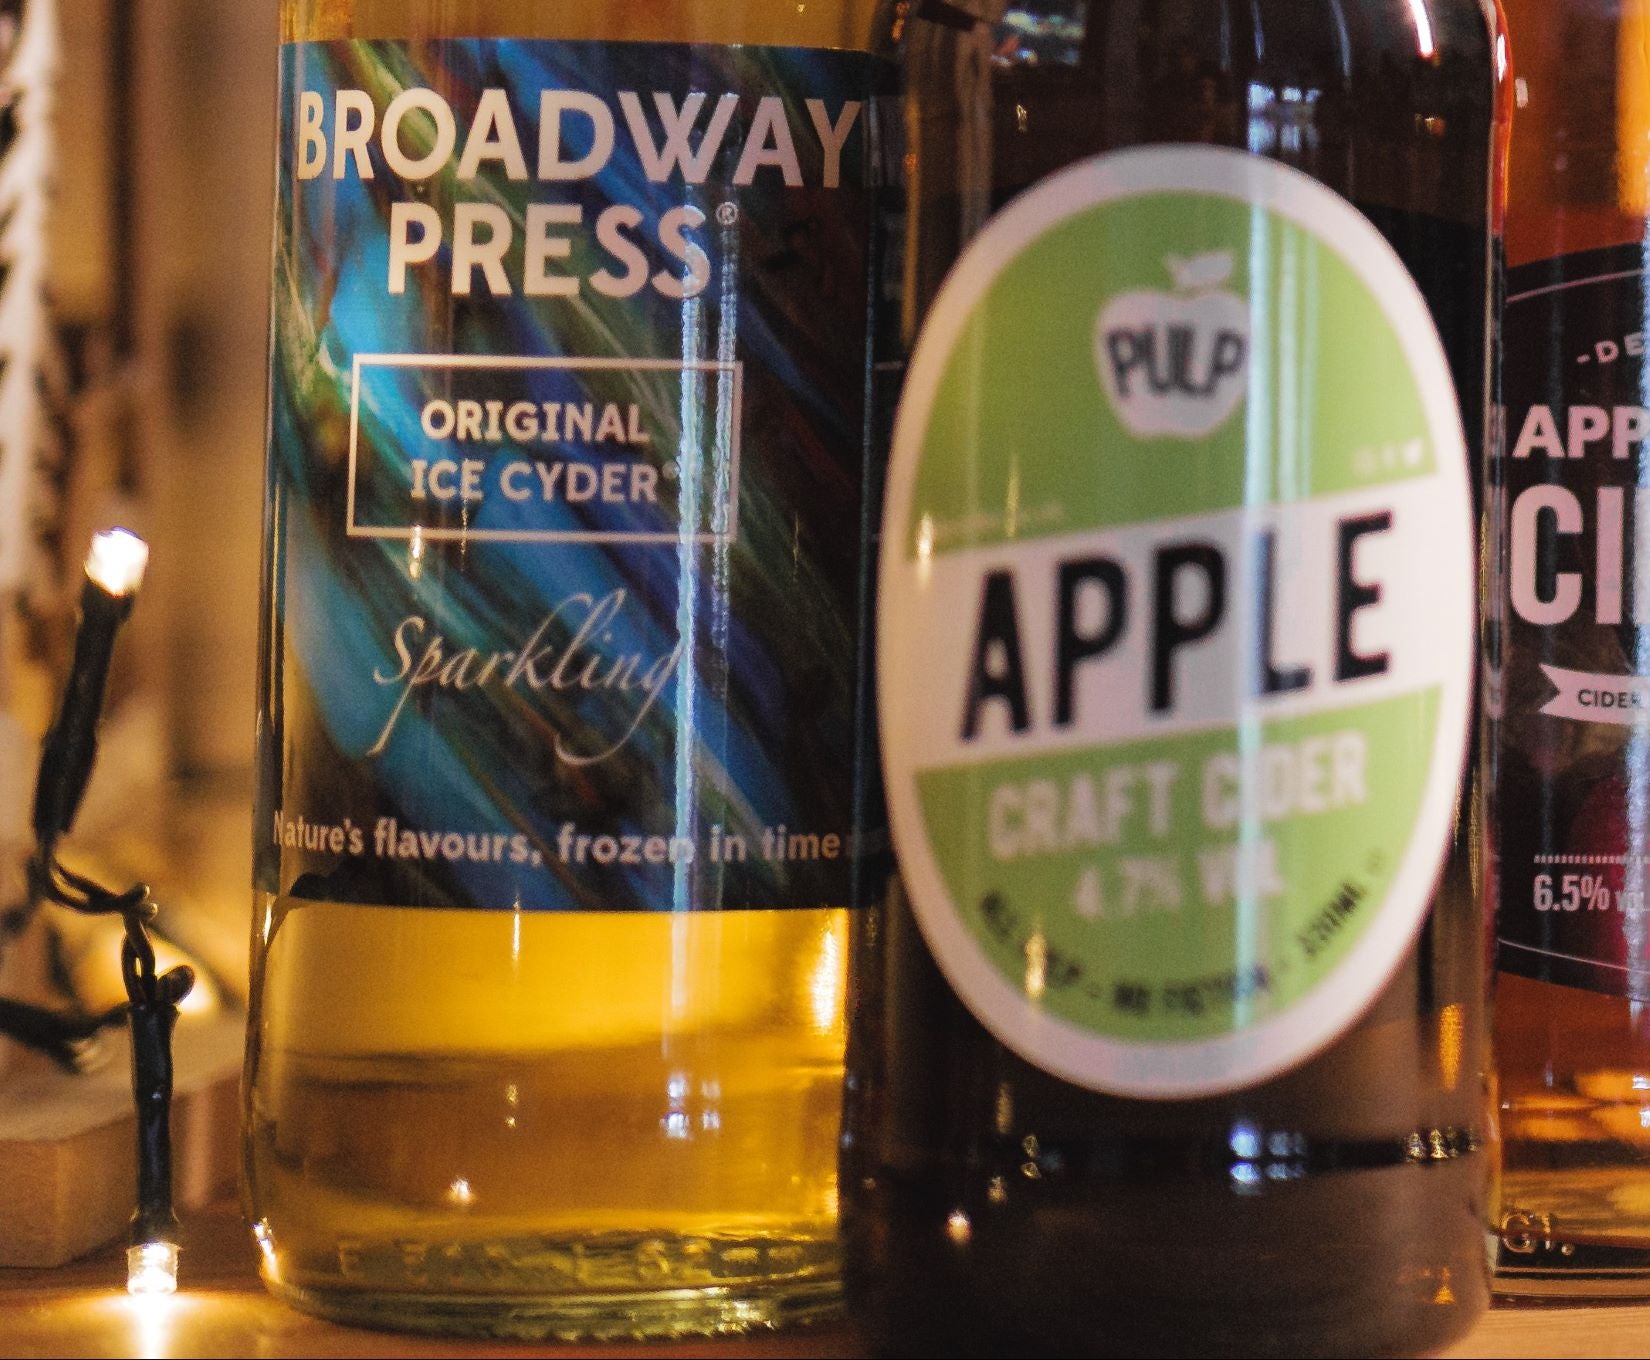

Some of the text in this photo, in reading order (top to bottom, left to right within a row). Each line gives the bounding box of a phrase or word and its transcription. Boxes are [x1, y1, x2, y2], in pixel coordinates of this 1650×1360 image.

[298, 88, 861, 188] BROADWAY
[1105, 322, 1246, 400] PULP
[420, 399, 651, 443] ORIGINAL
[409, 458, 484, 502] ICE
[960, 509, 1394, 742] APPLE
[366, 588, 686, 765] Sparkling
[274, 810, 842, 869] Nature's flavours, frozen in time
[988, 758, 1178, 859] CRAFT
[1533, 873, 1610, 913] 6.5%
